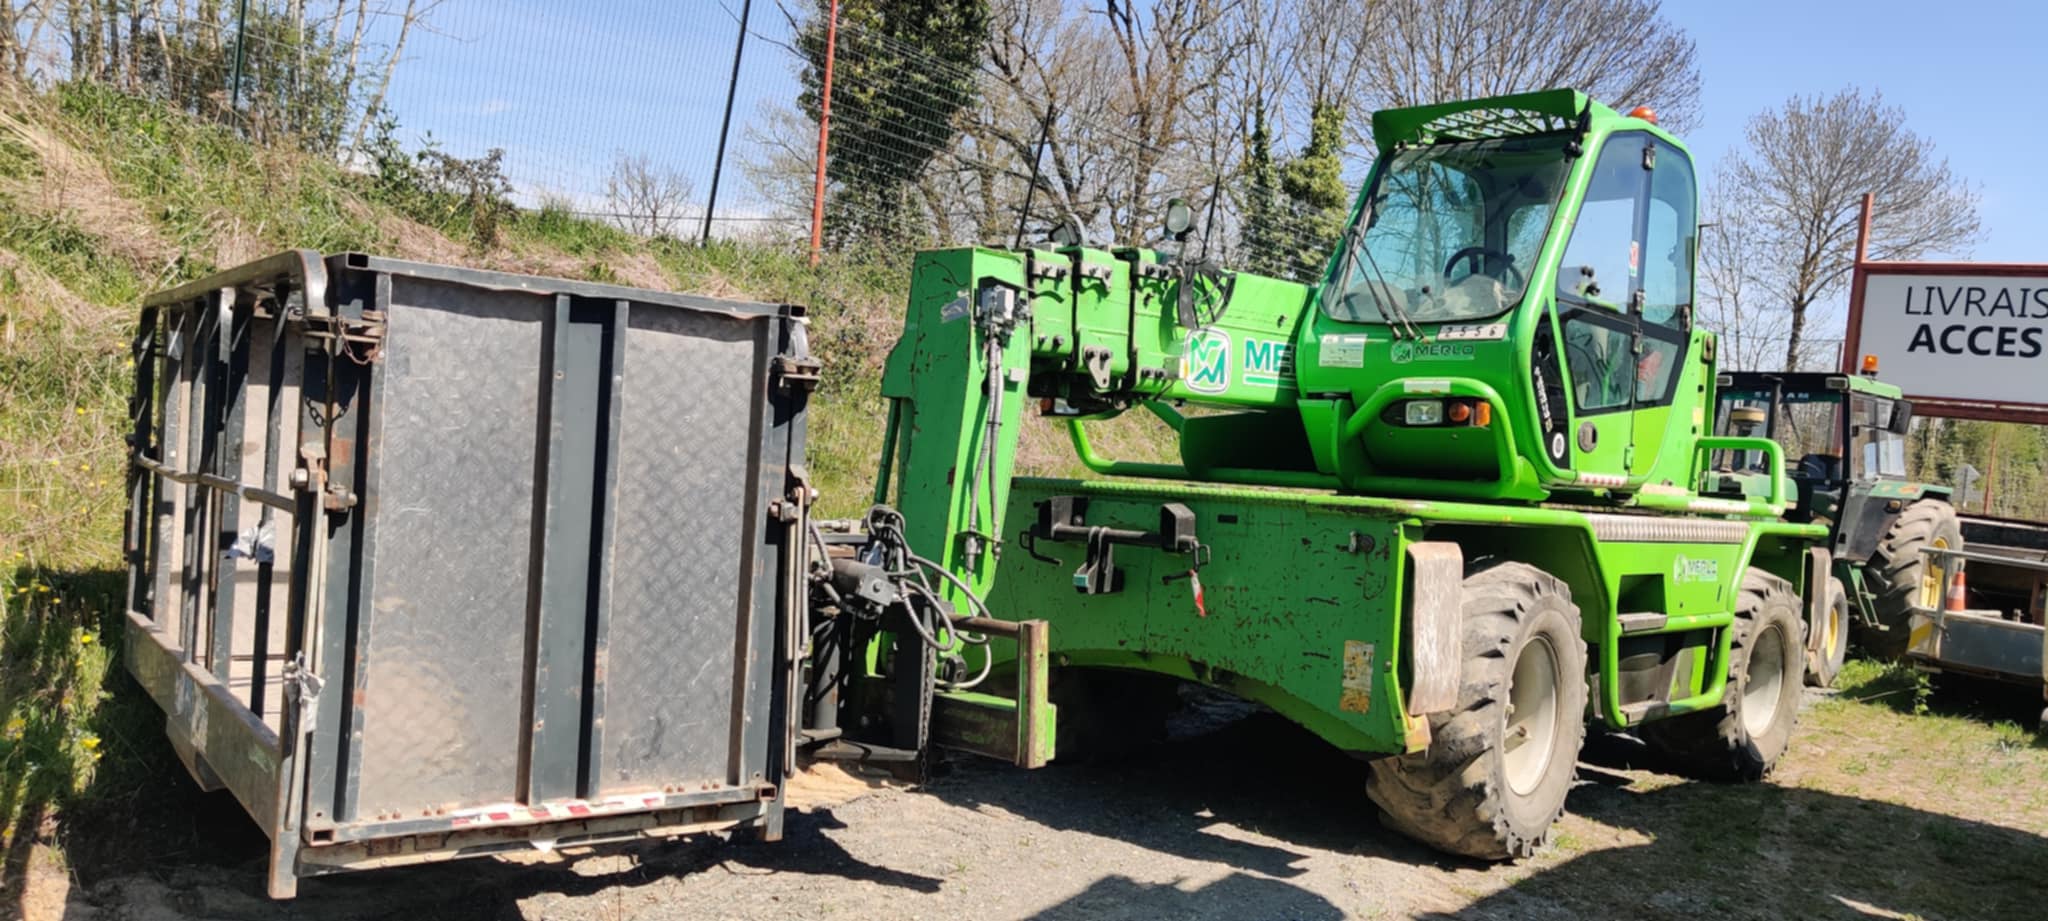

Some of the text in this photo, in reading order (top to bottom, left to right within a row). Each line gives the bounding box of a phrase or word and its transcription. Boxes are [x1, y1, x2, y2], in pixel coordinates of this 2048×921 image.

[1905, 286, 2048, 319] LIVRAIS
[1444, 325, 1498, 337] 2556
[1907, 323, 2043, 358] ACCES
[1415, 345, 1475, 356] MERLO
